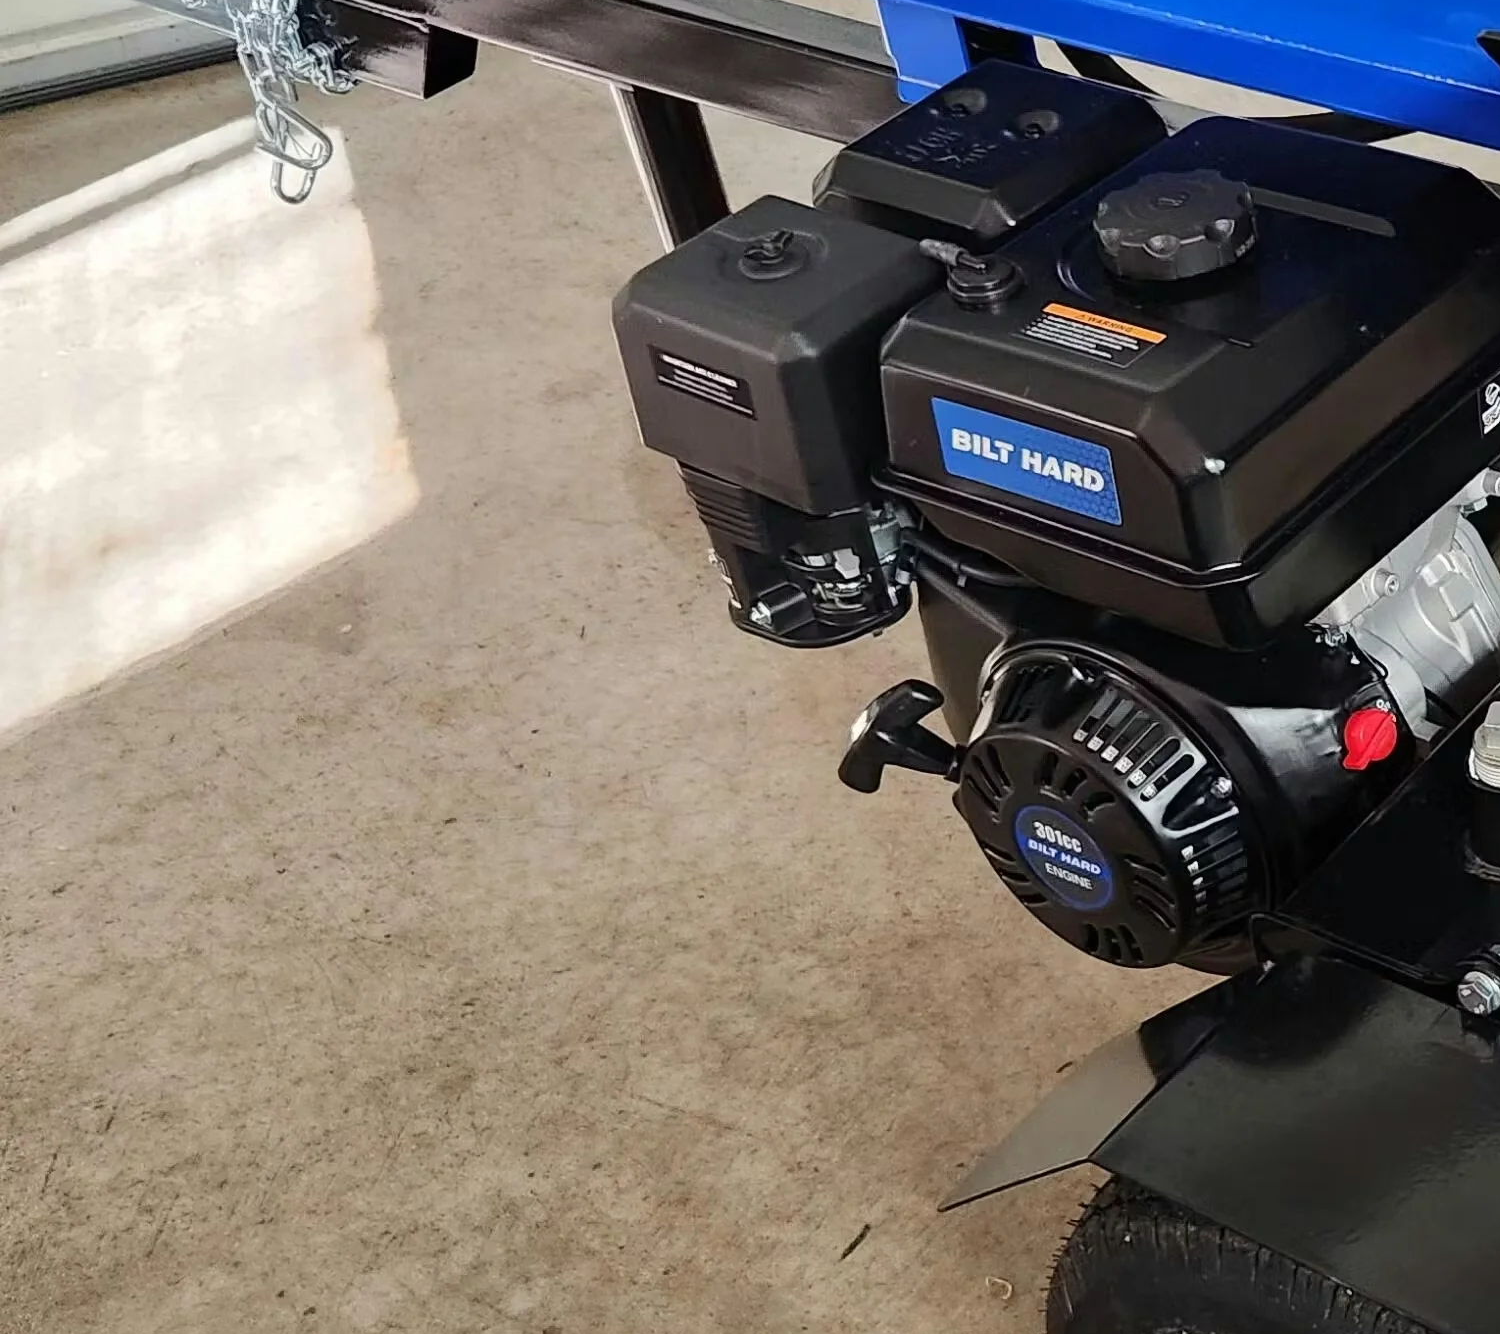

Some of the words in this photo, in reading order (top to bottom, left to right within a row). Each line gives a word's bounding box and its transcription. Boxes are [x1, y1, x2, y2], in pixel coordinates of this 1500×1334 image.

[1088, 317, 1134, 333] WARNING
[951, 428, 1015, 464] BILT
[1021, 448, 1105, 493] HARD
[1028, 839, 1058, 858] BILT
[1061, 851, 1101, 875] HARD
[1045, 862, 1093, 890] ENGINE
